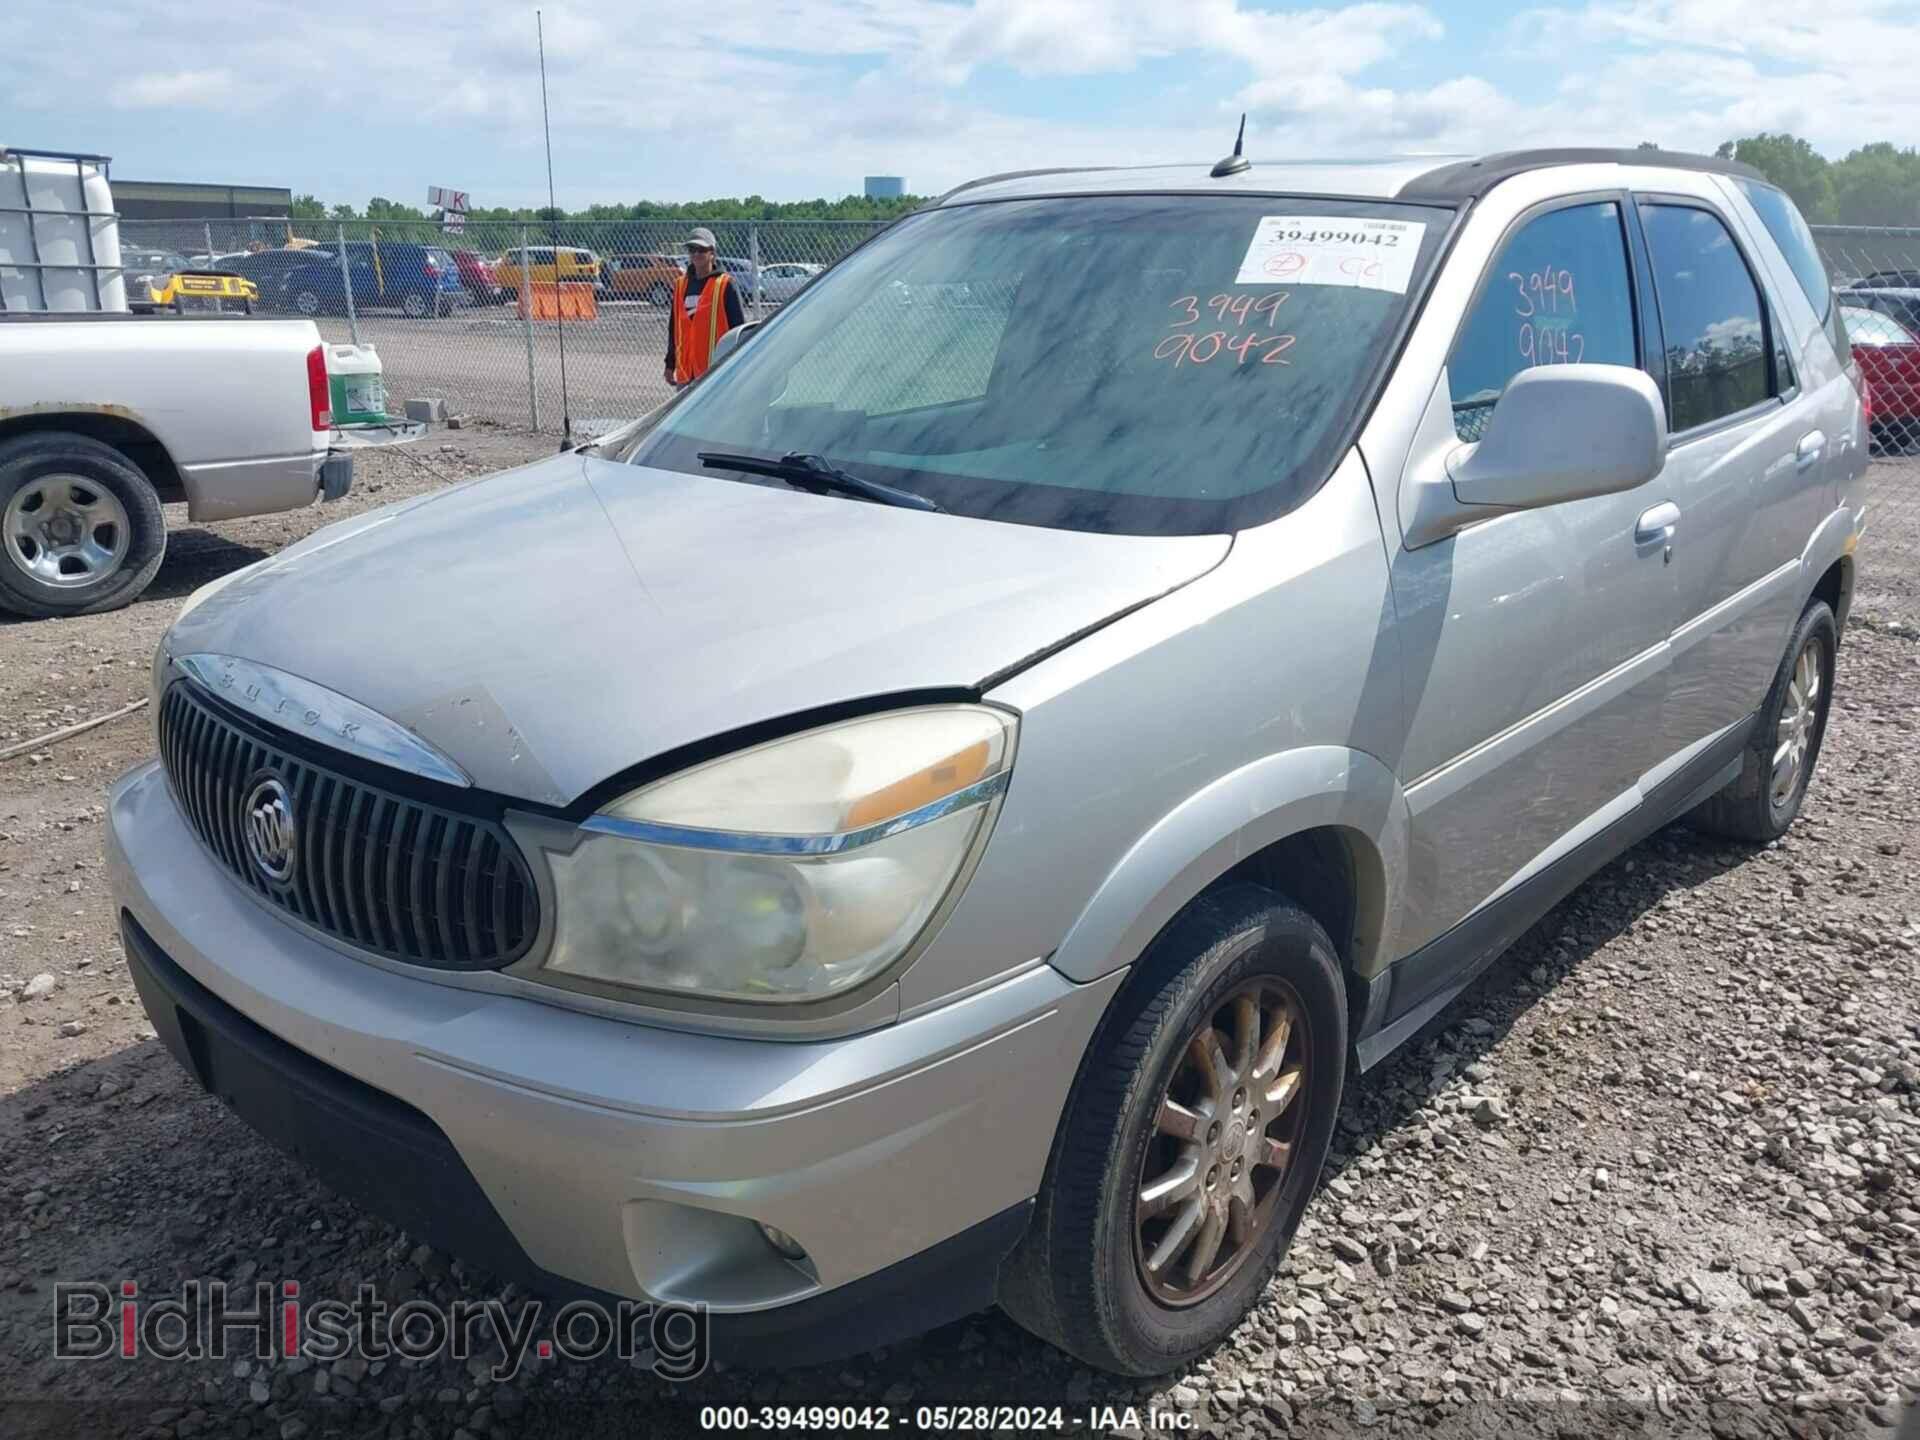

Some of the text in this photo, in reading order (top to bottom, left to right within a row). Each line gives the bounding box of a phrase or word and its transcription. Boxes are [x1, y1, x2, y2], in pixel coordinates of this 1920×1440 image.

[453, 191, 464, 209] K
[1270, 230, 1399, 247] 39499042
[1508, 264, 1577, 317] 3949
[1168, 291, 1290, 328] 3949
[1153, 331, 1297, 369] 9042
[219, 673, 361, 742] BUICK
